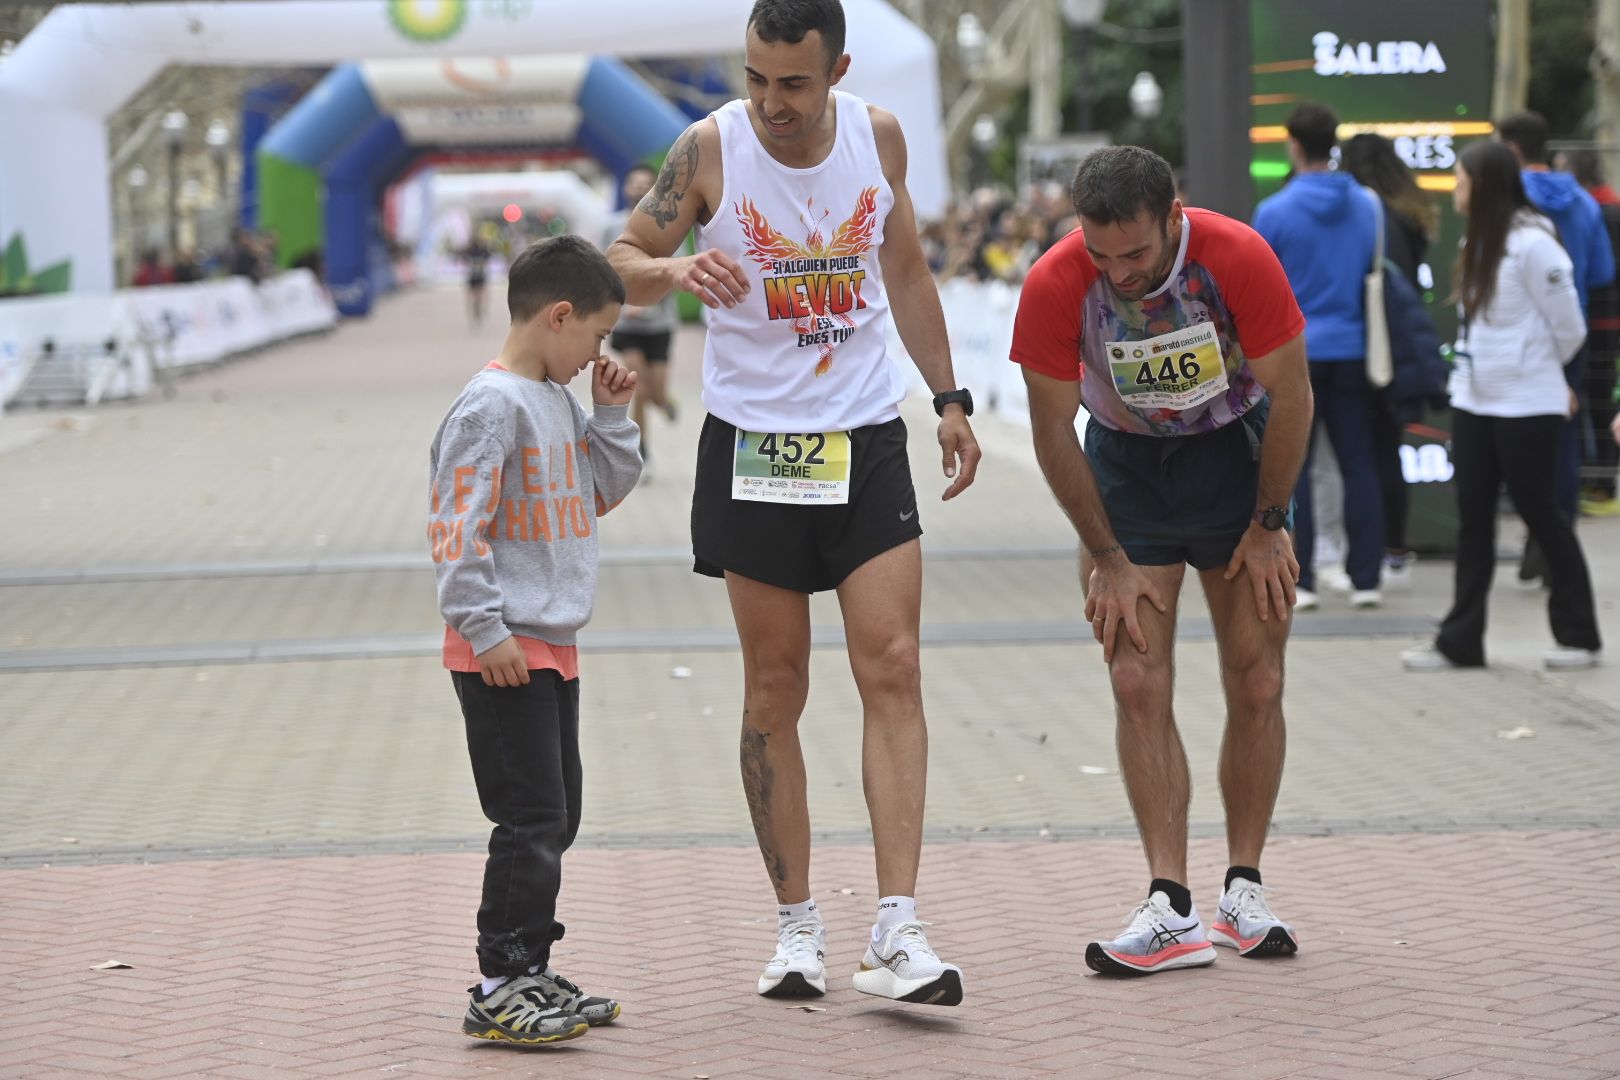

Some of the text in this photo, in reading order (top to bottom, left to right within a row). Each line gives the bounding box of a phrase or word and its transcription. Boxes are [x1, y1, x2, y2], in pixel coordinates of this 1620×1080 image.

[1312, 31, 1447, 76] SALERA
[772, 256, 860, 275] SI ALGUIEN PUEDE
[763, 269, 867, 321] NEVOT
[817, 317, 835, 331] ESE
[1181, 330, 1212, 348] CASTELLÓ
[1135, 352, 1201, 385] 446
[1144, 378, 1199, 393] FERRER
[757, 432, 825, 465] 452
[771, 464, 811, 479] DEME
